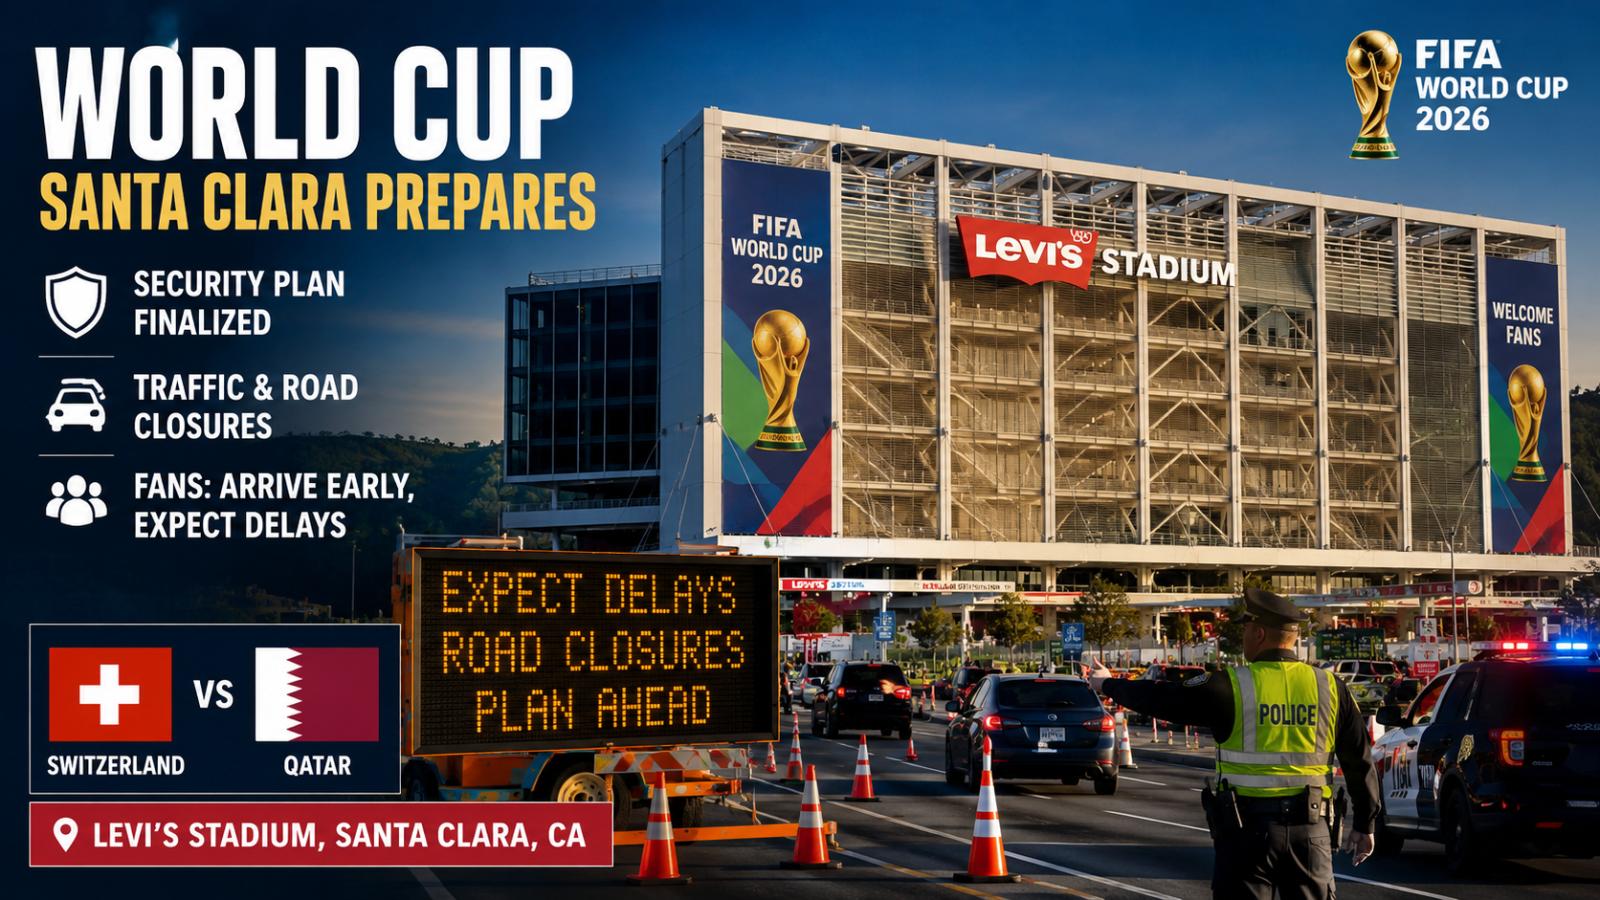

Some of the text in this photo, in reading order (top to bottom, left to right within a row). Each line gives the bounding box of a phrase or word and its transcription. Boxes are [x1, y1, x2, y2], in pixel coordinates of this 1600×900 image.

[752, 213, 802, 239] FIFA
[731, 237, 823, 264] WORLD CUP
[751, 263, 804, 288] 2026
[1101, 248, 1236, 287] STADIUM
[1492, 301, 1554, 324] WELCOME
[1506, 325, 1542, 347] FANS
[442, 570, 736, 614] EXPECT DELAYS
[442, 630, 745, 674] ROAD CLOSURES
[476, 685, 711, 733] PLAN AHEAD
[1259, 703, 1316, 726] POLICE
